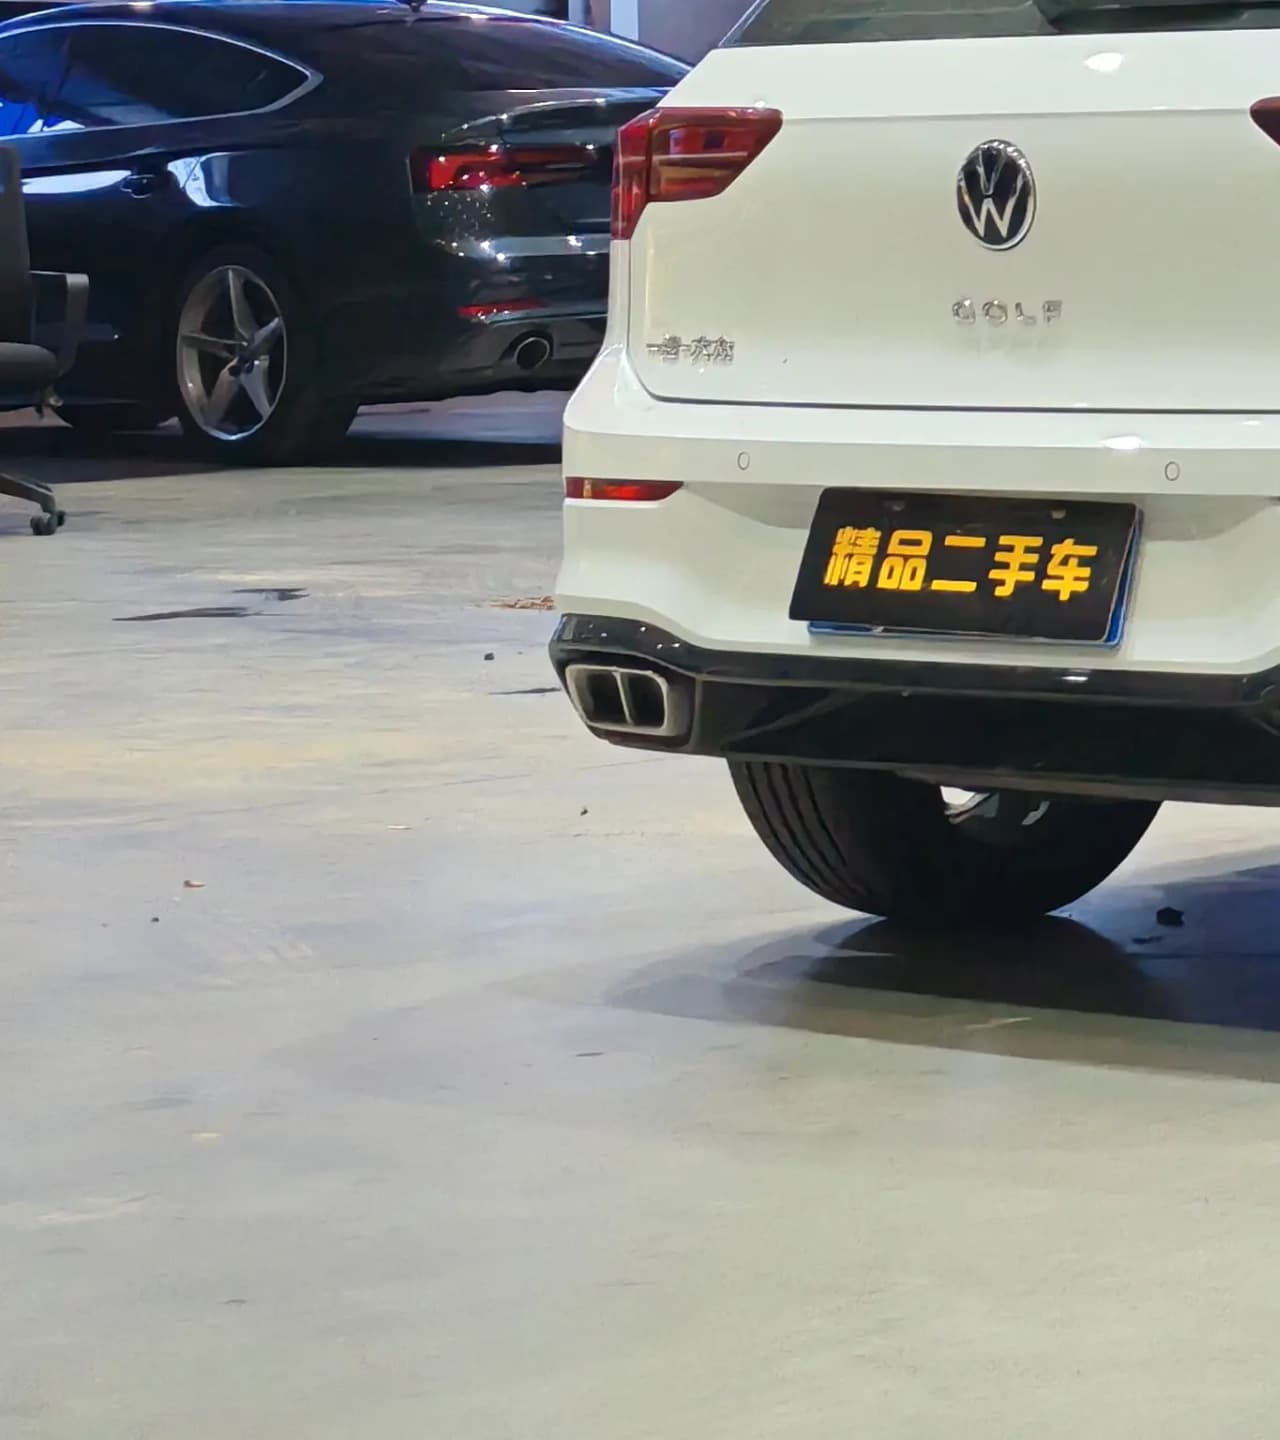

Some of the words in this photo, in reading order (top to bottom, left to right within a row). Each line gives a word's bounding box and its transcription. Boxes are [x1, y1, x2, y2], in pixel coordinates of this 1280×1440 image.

[952, 297, 1063, 326] GOLF
[823, 525, 1099, 602] 精品二手车
